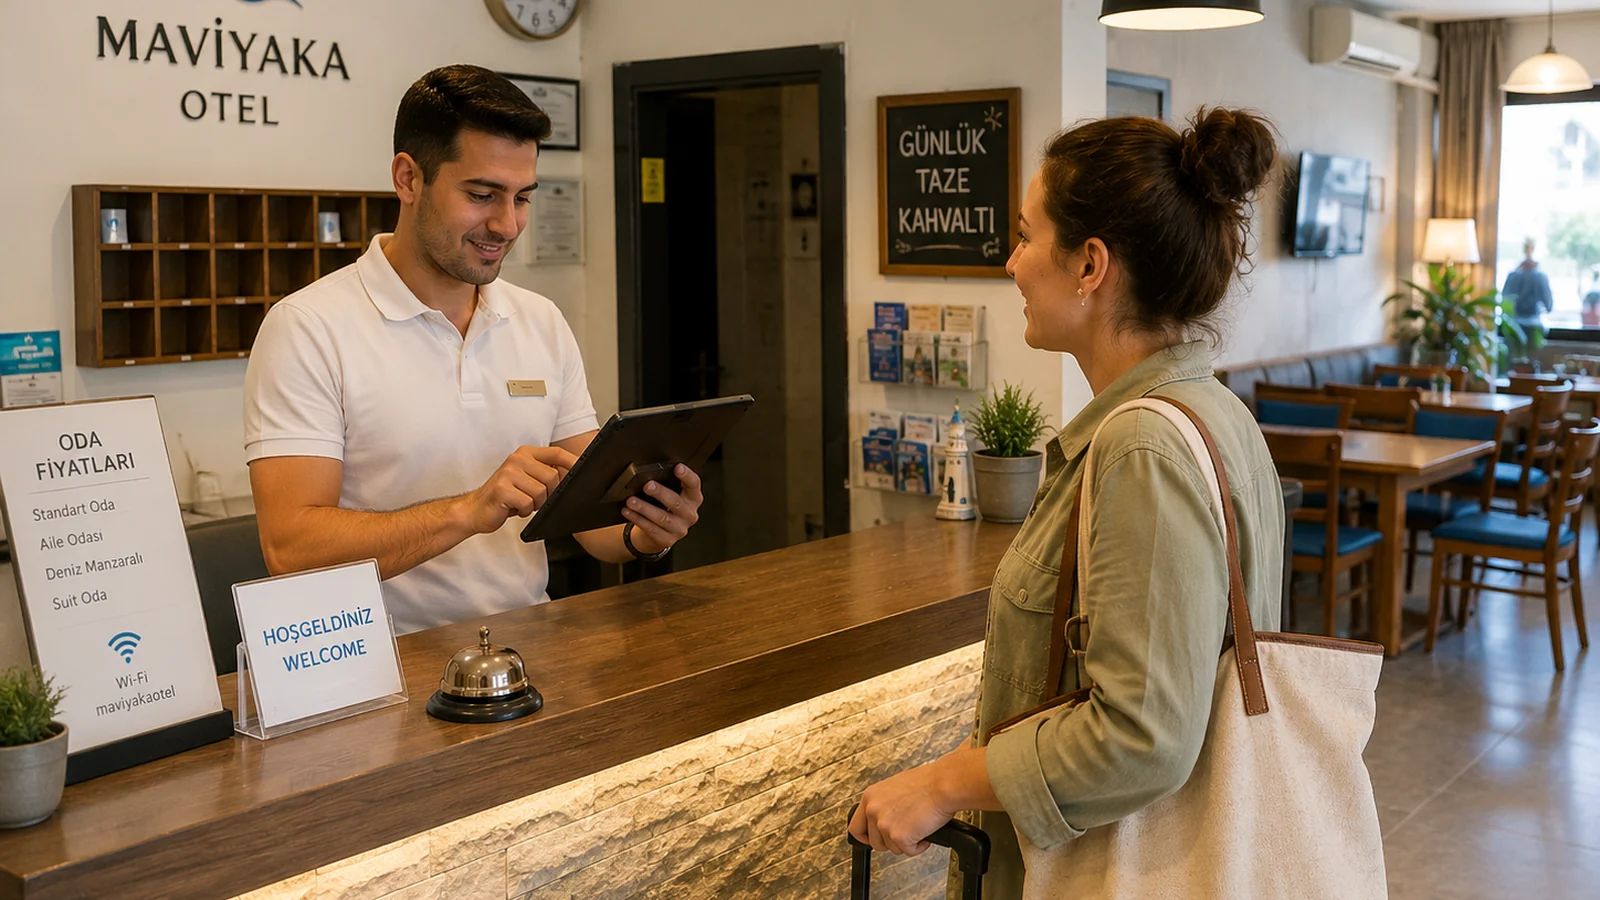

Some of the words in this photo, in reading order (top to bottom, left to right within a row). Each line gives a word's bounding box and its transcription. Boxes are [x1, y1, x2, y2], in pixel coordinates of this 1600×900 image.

[516, 4, 525, 20] 7
[531, 12, 540, 27] 6
[548, 9, 556, 24] 5
[97, 15, 351, 81] MAVİYAKA
[180, 90, 280, 126] OTEL
[900, 122, 987, 157] GÜNLÜK
[915, 167, 970, 194] TAZE
[899, 207, 994, 234] KAHVALTI
[59, 431, 103, 451] ODA
[36, 452, 135, 480] FİYATLARI
[32, 503, 87, 522] Standart
[89, 499, 116, 513] Oda
[40, 536, 64, 551] Aile
[45, 565, 83, 581] Deniz
[85, 552, 144, 574] Manzaralı
[52, 594, 79, 611] Suit
[81, 590, 108, 605] Oda
[263, 606, 374, 646] HOŞGELDİNİZ
[282, 639, 367, 672] WELCOME
[115, 670, 149, 690] Wi-Fi
[96, 685, 176, 717] maviyakaotel
